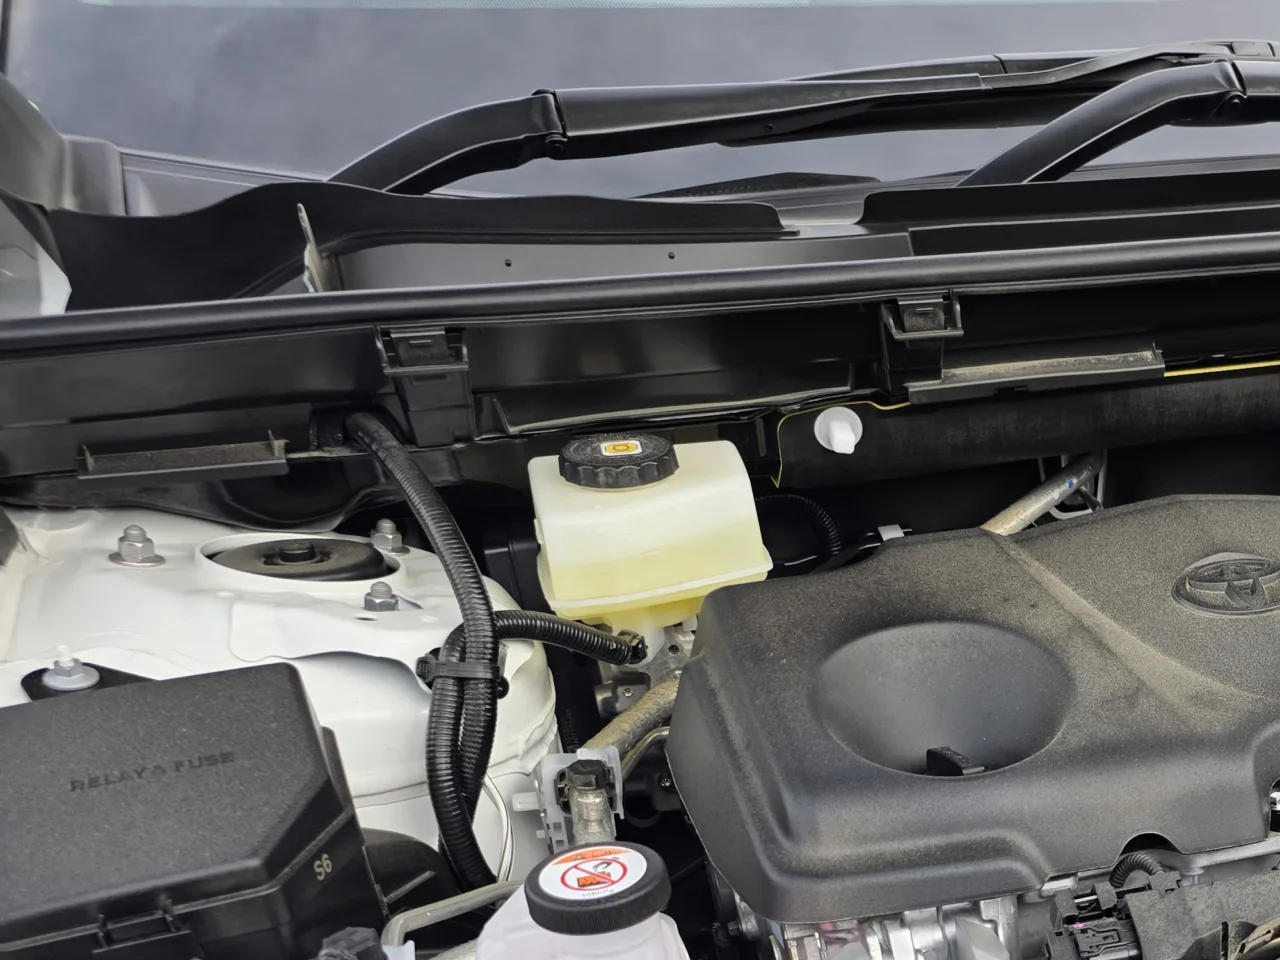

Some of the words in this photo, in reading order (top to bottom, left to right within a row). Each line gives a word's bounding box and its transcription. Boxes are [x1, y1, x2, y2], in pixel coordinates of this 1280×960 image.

[69, 766, 148, 793] RELAY
[174, 751, 236, 772] FUSE
[314, 853, 332, 881] S6
